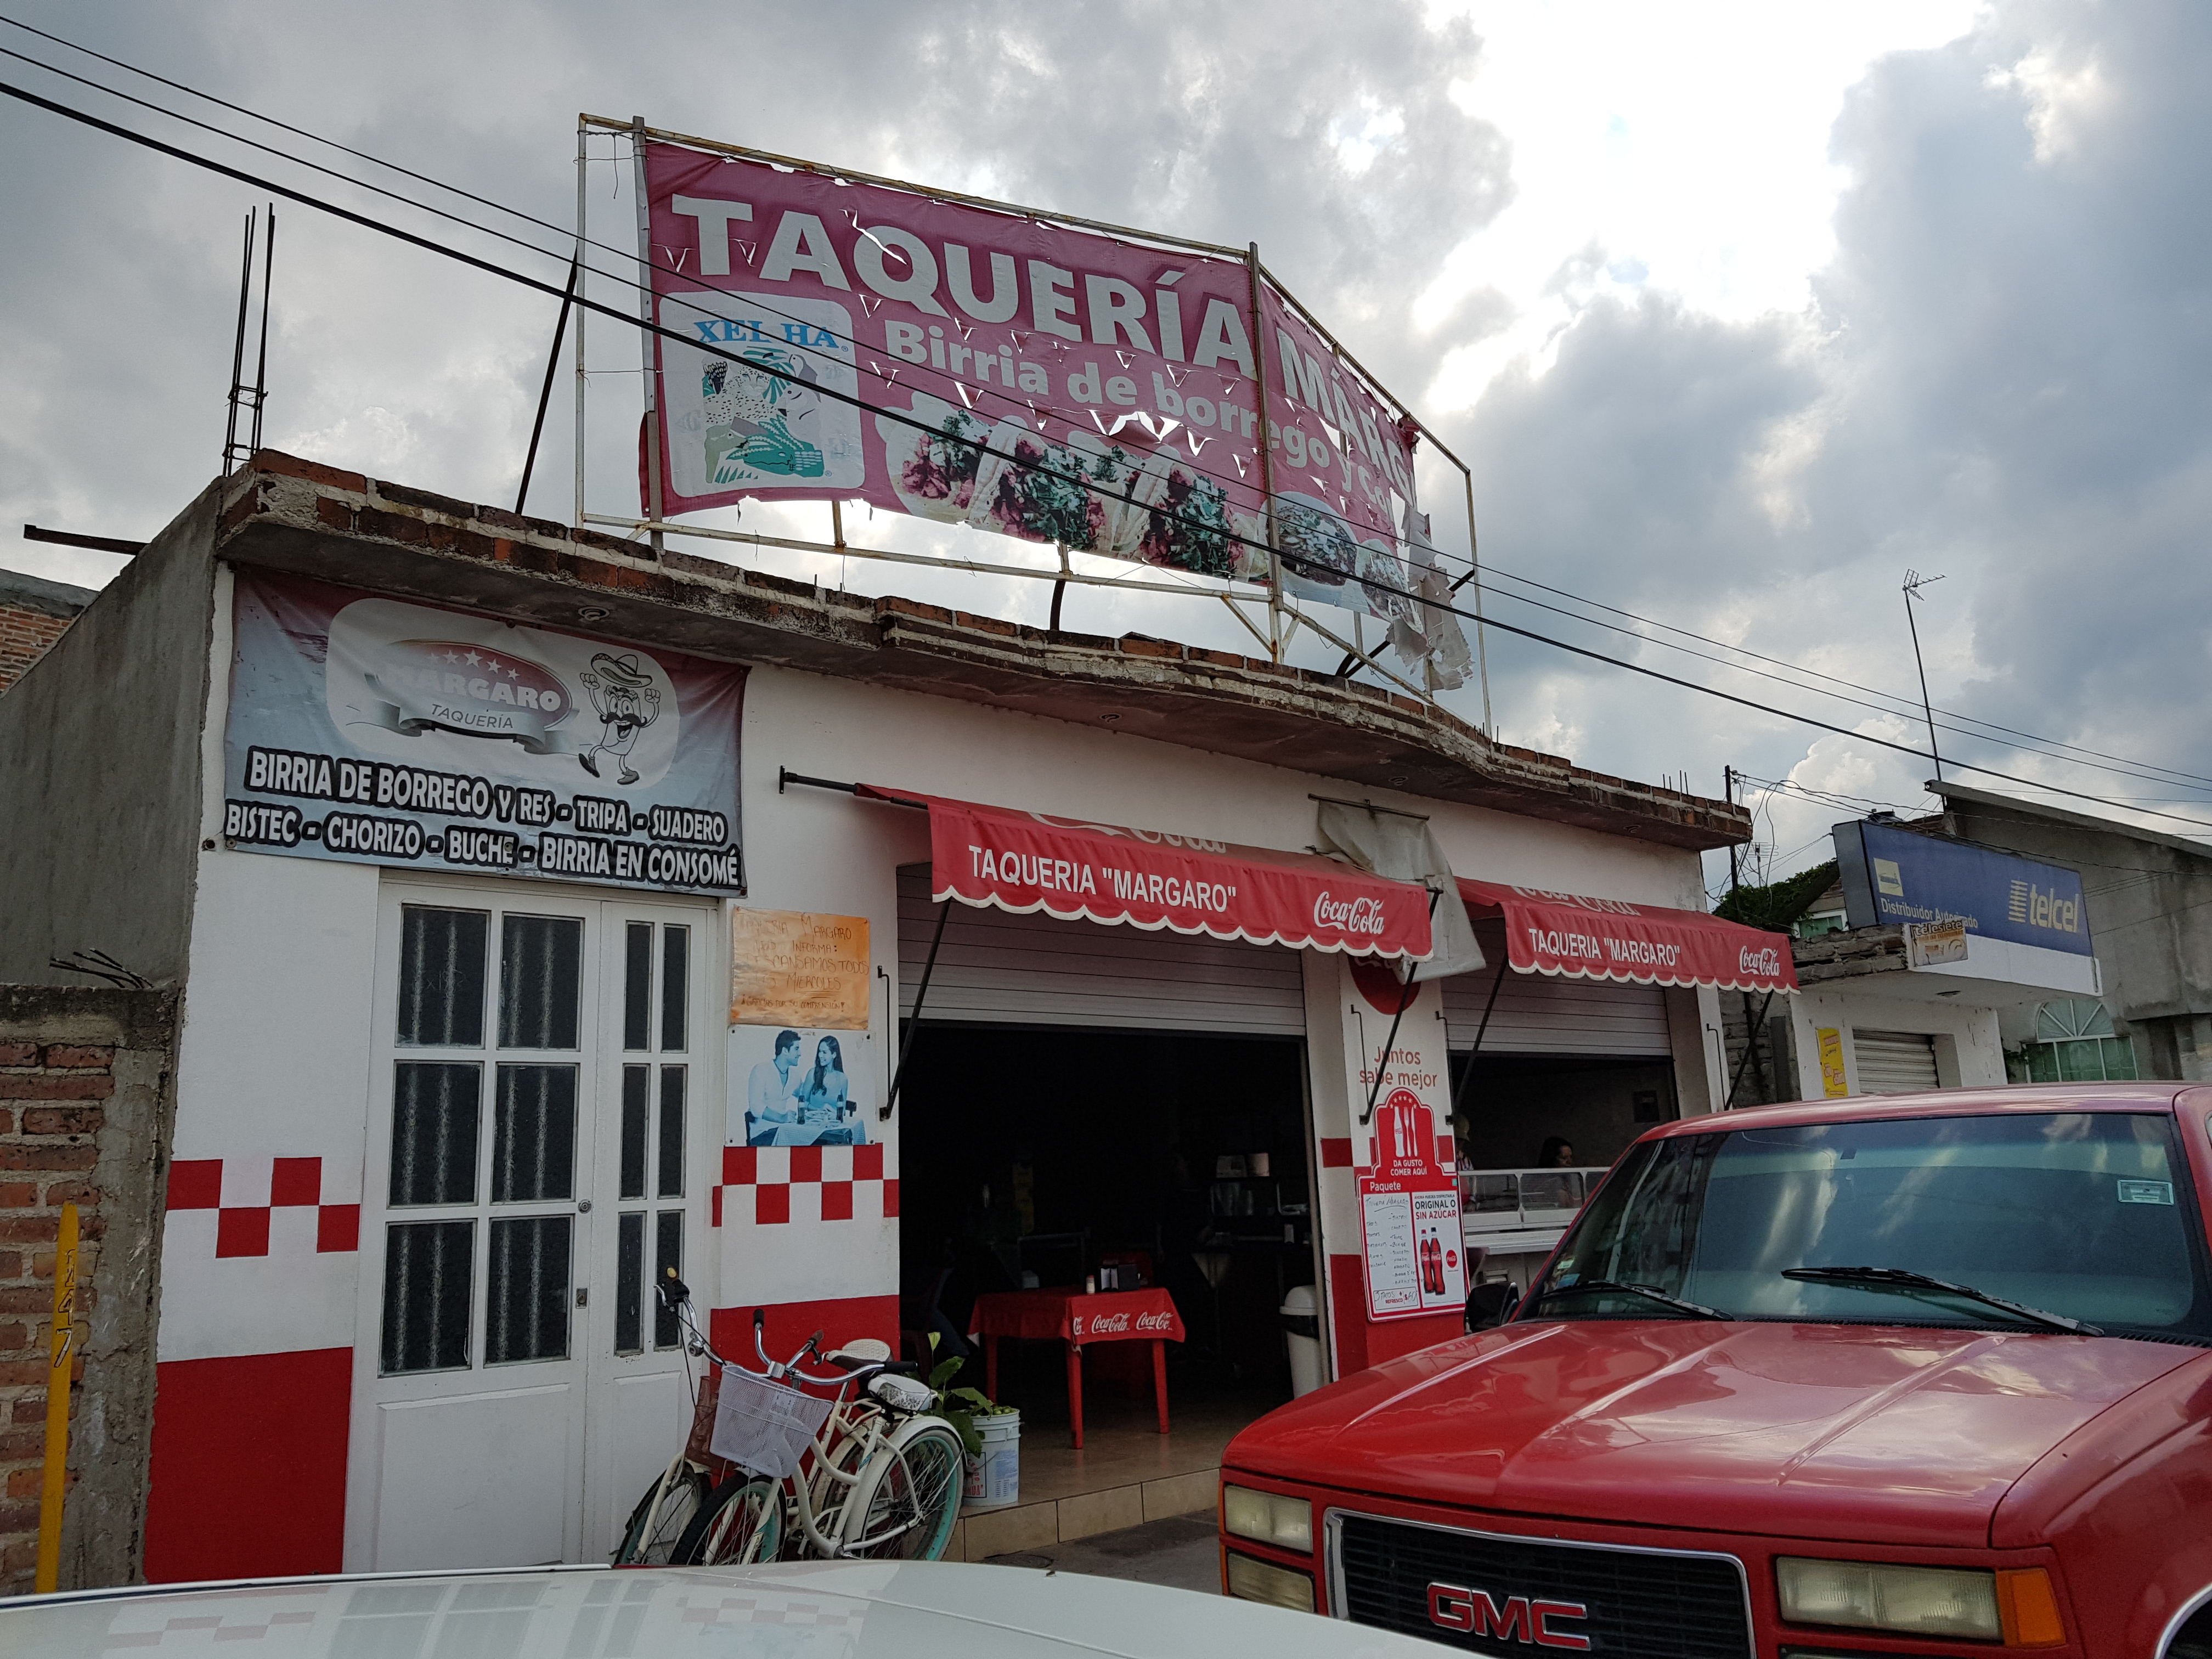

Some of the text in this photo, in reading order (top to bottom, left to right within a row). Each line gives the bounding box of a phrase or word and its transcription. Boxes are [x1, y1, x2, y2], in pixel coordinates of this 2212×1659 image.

[671, 193, 1259, 381] TAQUERÍA
[693, 319, 839, 348] XEL HA
[885, 319, 1048, 396] Birria
[1067, 362, 1137, 407] de
[1151, 370, 1330, 469] borrego
[431, 703, 514, 729] TAQUERÍA
[249, 751, 332, 797] BIRRIA
[339, 763, 372, 801] DE
[376, 767, 489, 815] BORREGO
[498, 789, 511, 818] Y
[520, 792, 551, 823] RES
[577, 799, 628, 832] TRIPA
[651, 808, 725, 843] SUADERO
[225, 803, 297, 843] BISTEC
[327, 815, 421, 855] CHORIZO
[449, 830, 515, 865] BUCHE
[541, 836, 611, 875] BIRRIA
[615, 844, 644, 878] EN
[648, 847, 739, 886] CONSOMÉ
[968, 844, 1237, 913] TAQUERIA "MARGARO"
[1881, 897, 1978, 929] Distribuidor Autoado
[2030, 883, 2079, 933] telcel
[800, 915, 852, 944] MARGARO
[1528, 928, 1680, 967] TAQUERIA "MARGARO"
[838, 960, 870, 976] TODOS
[1374, 1046, 1421, 1065] Jntos
[1397, 1069, 1437, 1090] mejor
[1390, 1168, 1412, 1176] COMER
[1403, 1159, 1423, 1167] GUSTO
[1369, 1181, 1401, 1193] Paquete
[1415, 1199, 1456, 1210] ORIGINAL O
[1416, 1211, 1427, 1220] SIN
[1427, 1582, 1592, 1651] GMC
